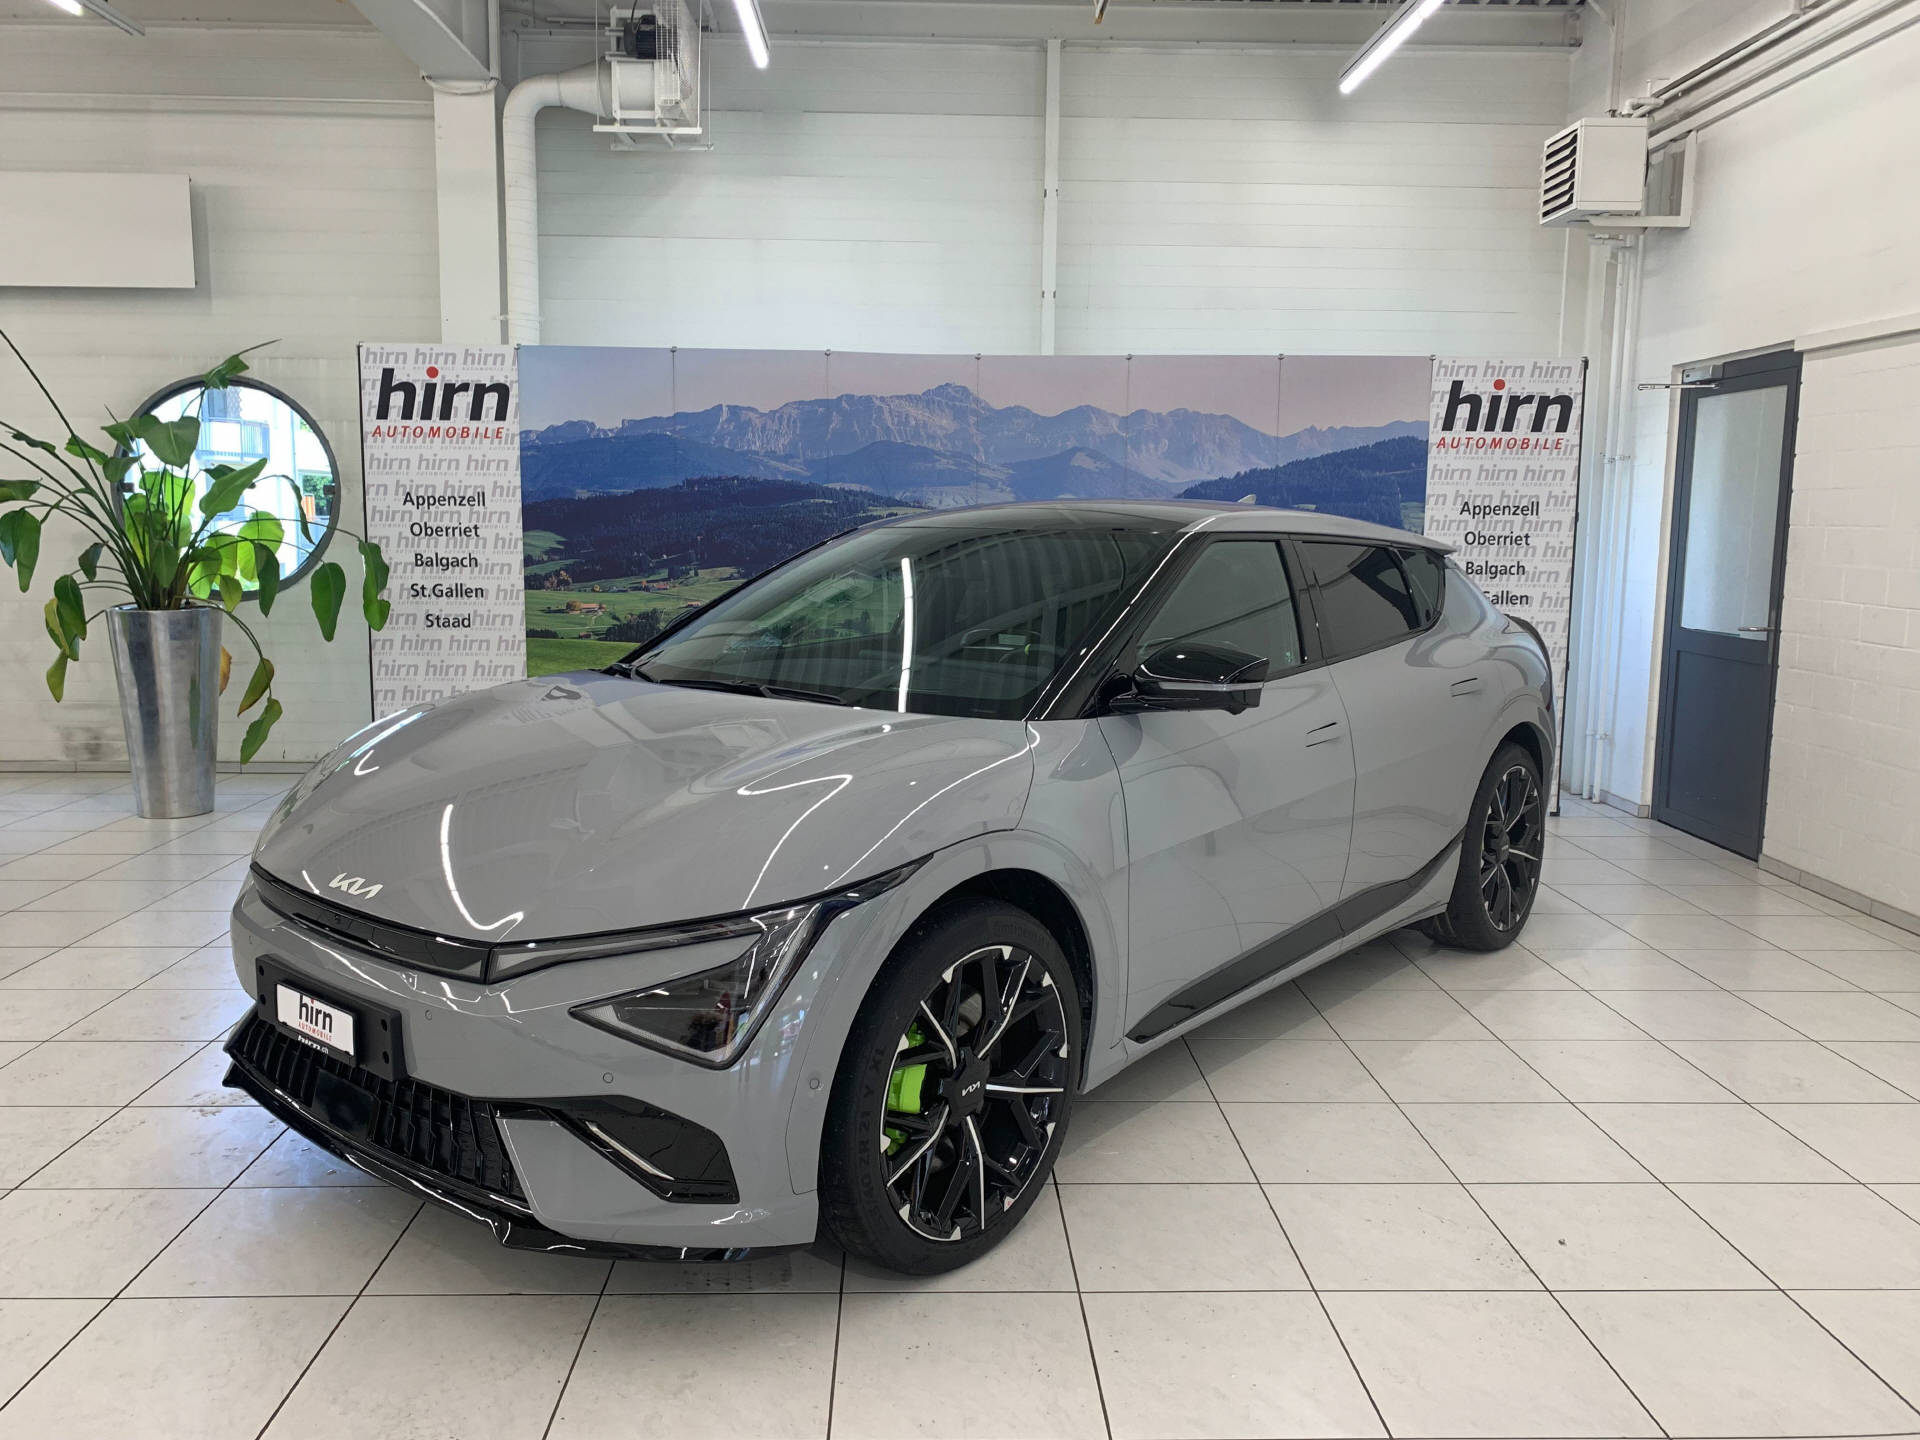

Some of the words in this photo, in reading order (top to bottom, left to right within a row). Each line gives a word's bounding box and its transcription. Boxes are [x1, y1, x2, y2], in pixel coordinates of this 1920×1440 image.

[364, 347, 408, 365] hirn
[413, 348, 457, 365] hirn
[462, 348, 506, 366] hirn
[1435, 360, 1478, 377] hirn
[1482, 360, 1525, 378] hirn
[1529, 360, 1573, 379] hirn
[376, 366, 510, 421] hirn
[1441, 379, 1574, 433] hirn
[371, 425, 504, 439] AUTOMOBILE
[1436, 437, 1565, 450] AUTOMOBILE
[368, 453, 411, 470] hirn
[417, 453, 460, 470] hirn
[466, 454, 509, 471] hirn
[1430, 464, 1472, 480] hirn
[1476, 464, 1518, 481] hirn
[1523, 465, 1566, 481] hirn
[402, 491, 486, 510] Appenzell
[1459, 500, 1540, 519] Appenzell
[370, 505, 414, 522] hirn
[410, 521, 480, 539] Oberriet
[1464, 531, 1531, 546] Oberriet
[414, 552, 479, 571] Balgach
[1465, 560, 1526, 579] Balgach
[410, 582, 485, 599] St.Gallen
[425, 613, 471, 628] Staad
[471, 609, 514, 626] hirn
[399, 634, 443, 651] hirn
[449, 634, 491, 652] hirn
[376, 659, 419, 677] hirn
[424, 659, 467, 677] hirn
[472, 659, 515, 677] hirn
[328, 871, 385, 899] KIA
[298, 993, 333, 1033] hirn
